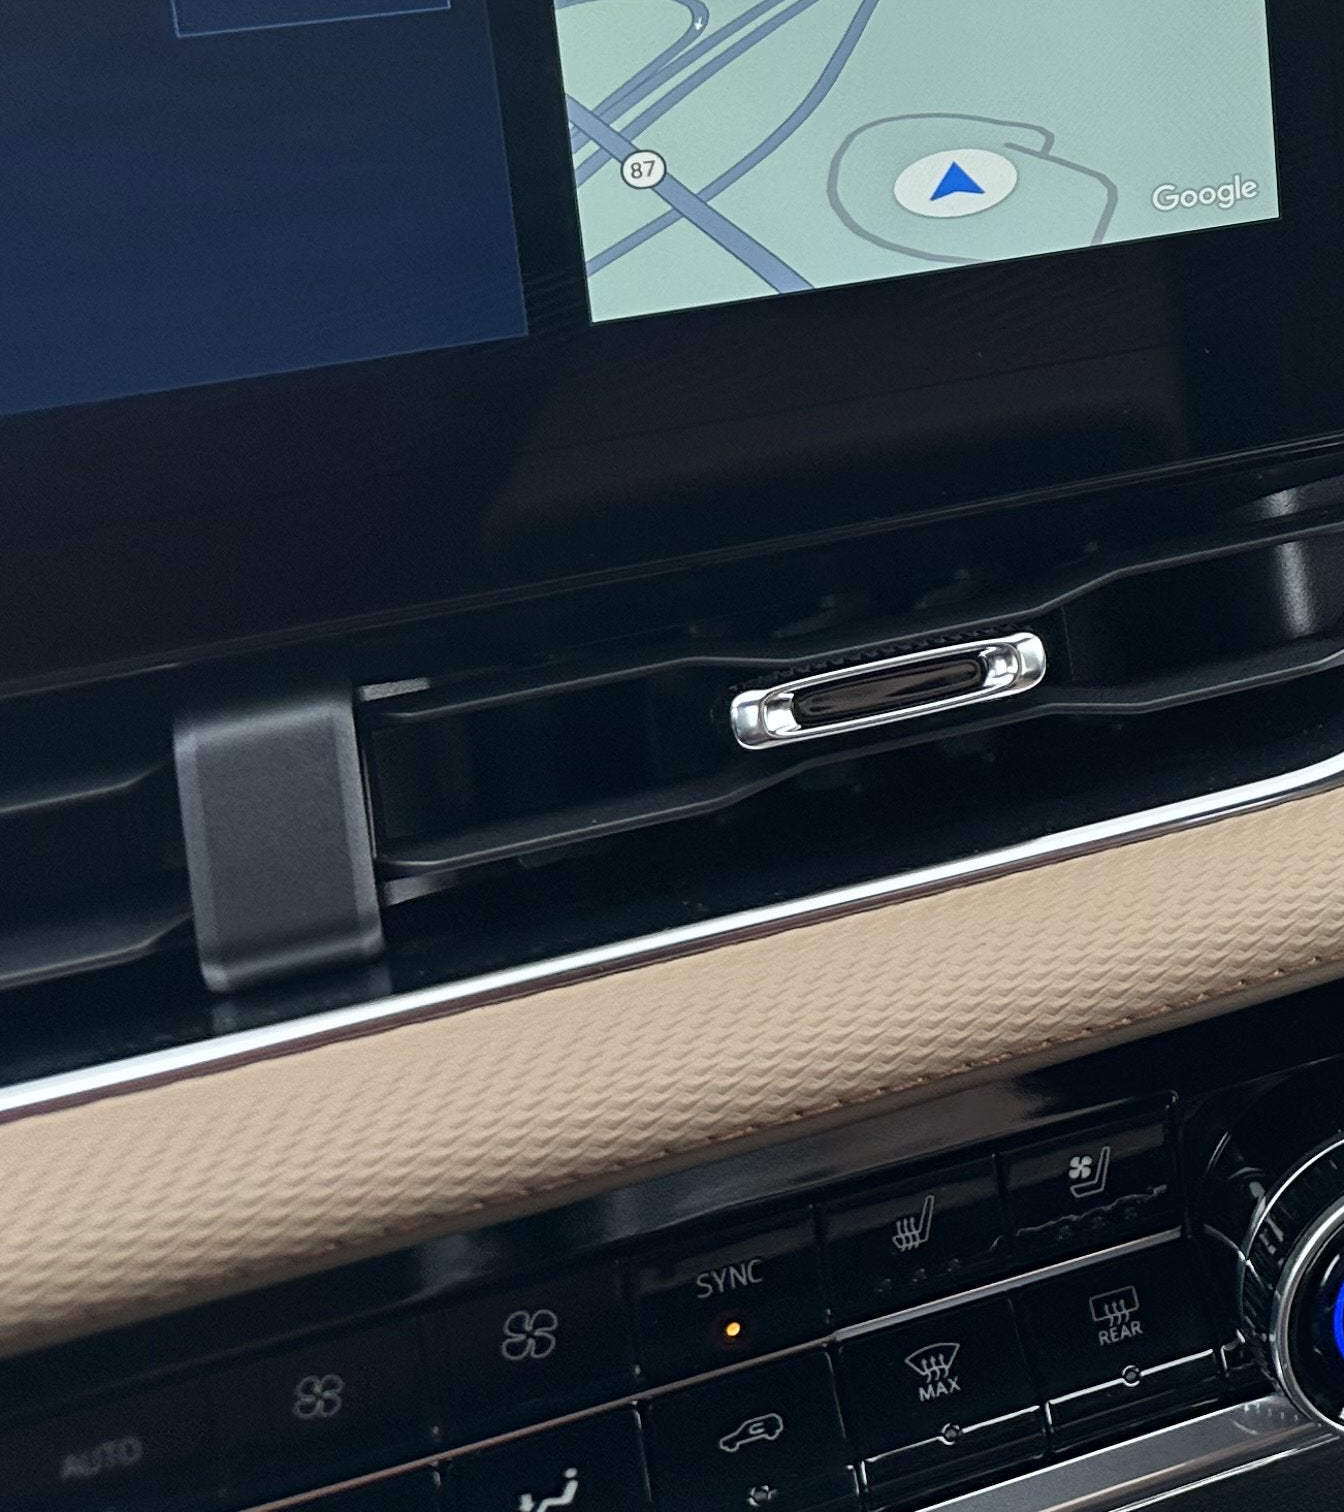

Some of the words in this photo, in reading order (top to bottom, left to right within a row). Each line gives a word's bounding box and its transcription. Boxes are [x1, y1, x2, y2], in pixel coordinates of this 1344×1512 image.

[629, 159, 656, 180] 87
[1152, 174, 1258, 213] Google
[695, 1258, 764, 1299] SYNC
[1098, 1320, 1143, 1346] REAR
[918, 1376, 961, 1402] MAX
